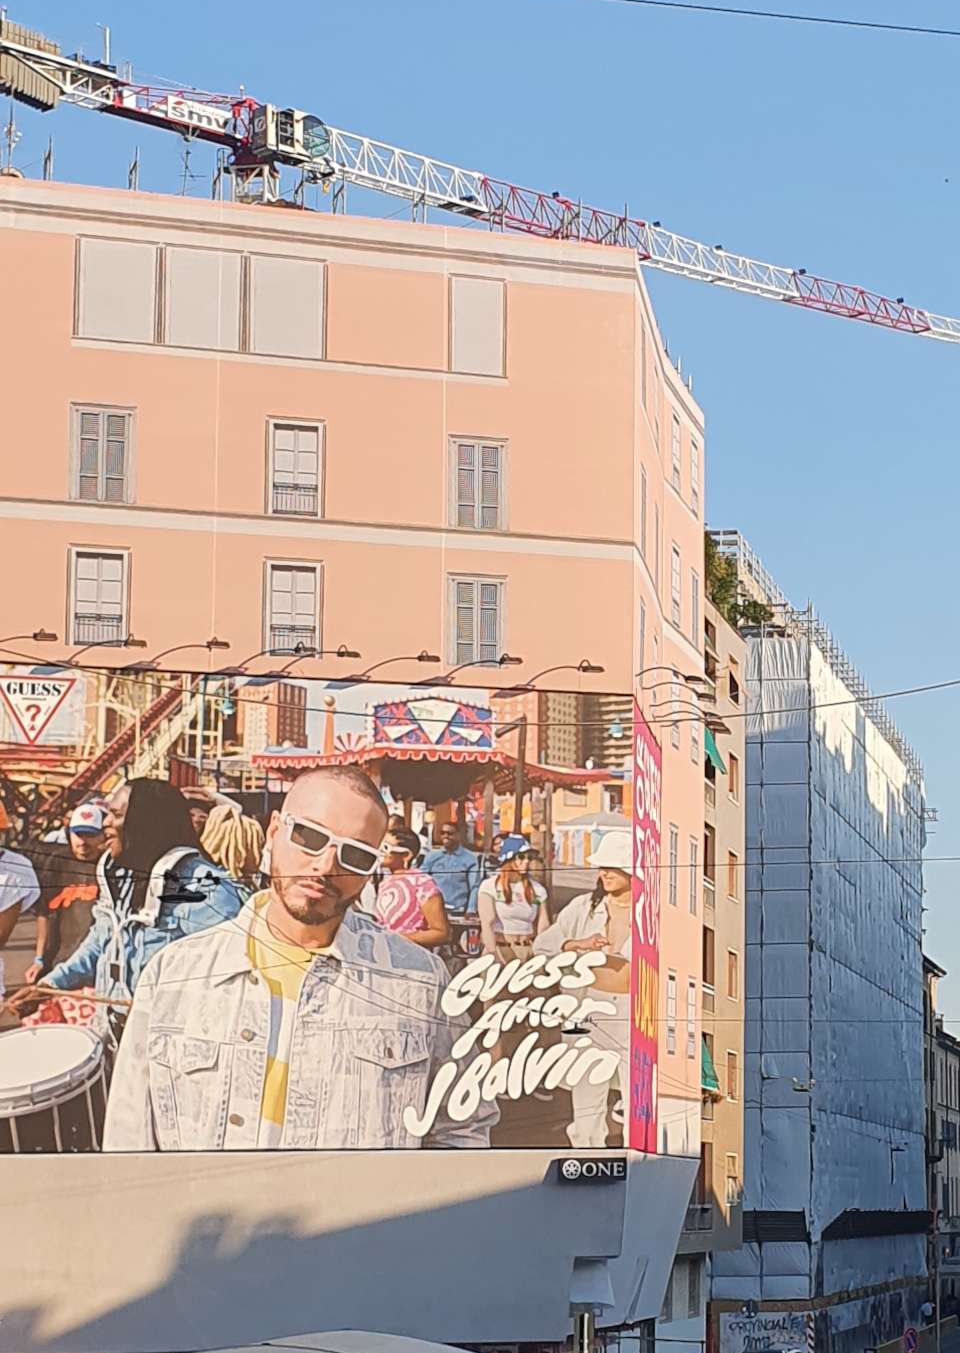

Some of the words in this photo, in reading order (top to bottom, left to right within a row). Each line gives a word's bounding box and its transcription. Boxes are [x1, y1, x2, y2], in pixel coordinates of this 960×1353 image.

[6, 681, 61, 696] GUESS
[403, 1062, 458, 1137] J
[447, 1032, 611, 1121] Balvin
[582, 1161, 625, 1177] ONE
